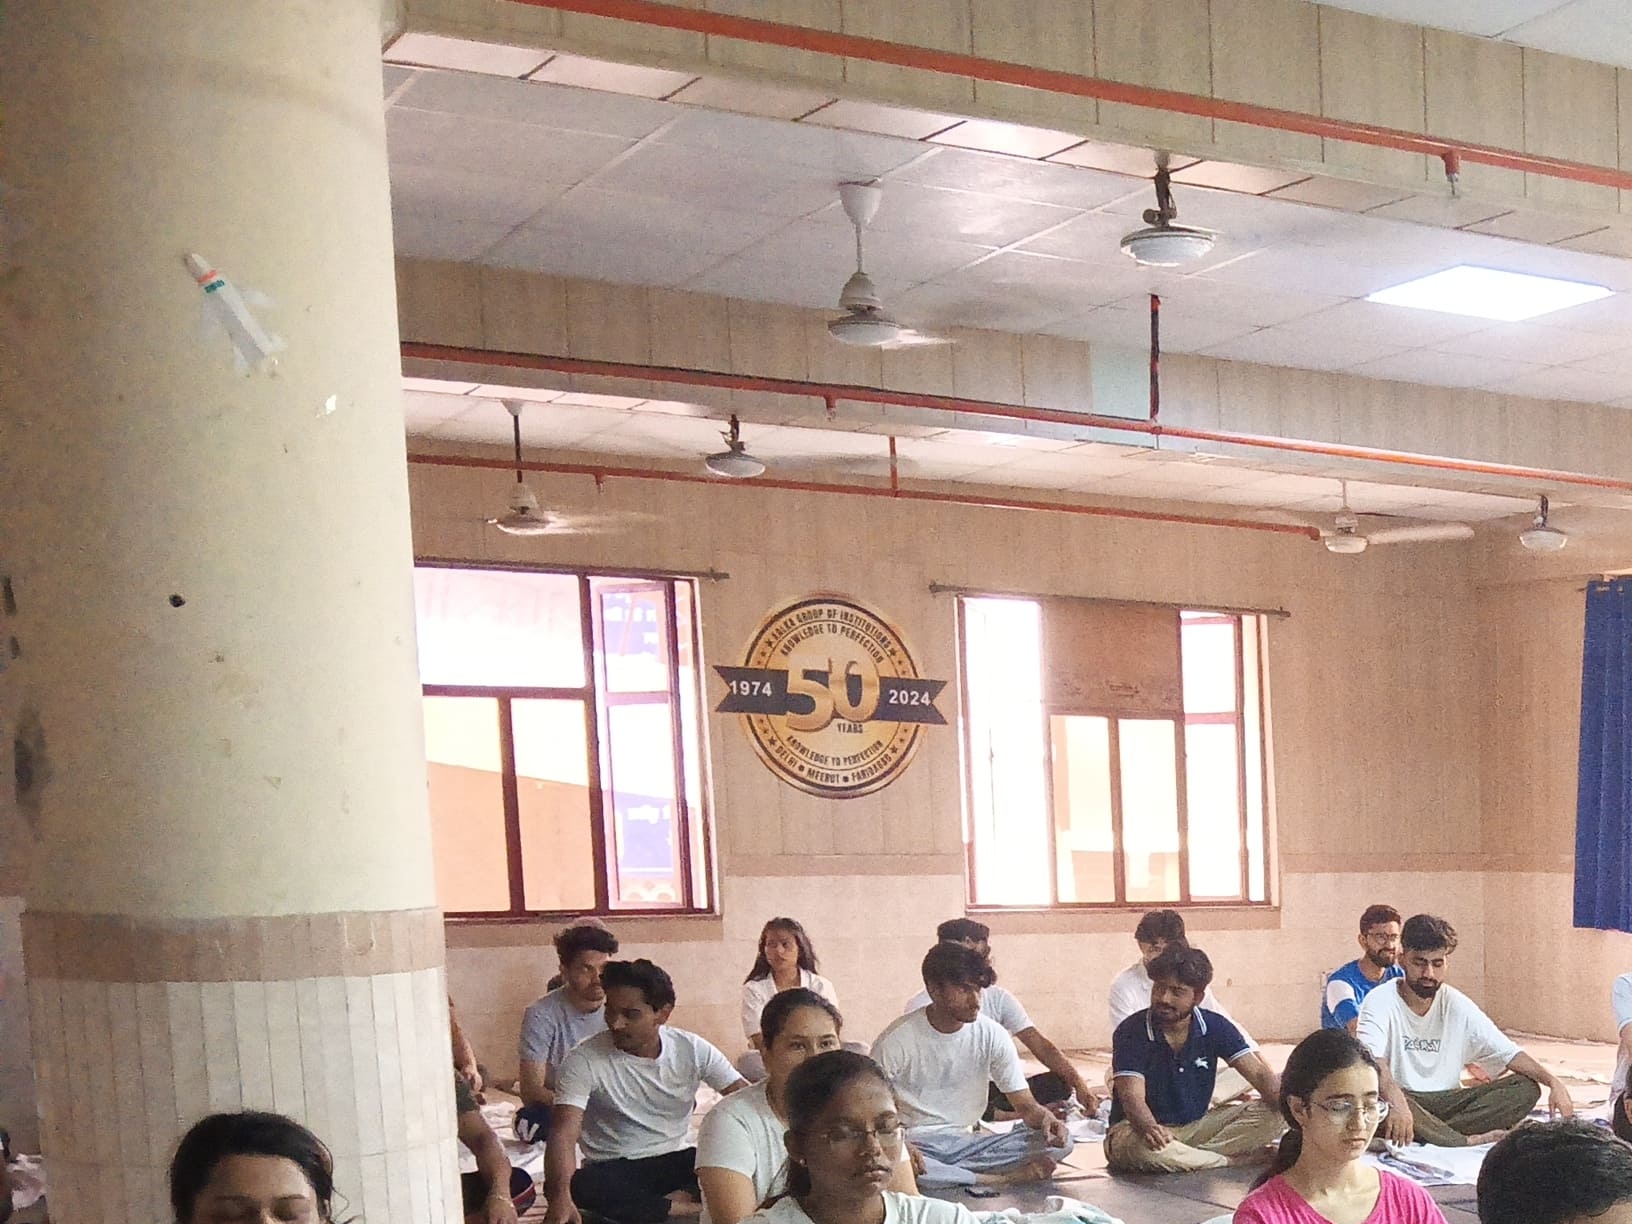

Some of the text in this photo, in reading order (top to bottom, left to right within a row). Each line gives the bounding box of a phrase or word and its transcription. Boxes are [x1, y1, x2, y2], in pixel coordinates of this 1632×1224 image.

[771, 608, 893, 649] KALKA GROUP OF INSTITUTIONS
[780, 624, 884, 663] KNOWLEDGE TO PERFECTION
[729, 680, 772, 697] 1974
[786, 655, 880, 733] 50
[888, 689, 931, 706] 2024
[837, 722, 863, 734] YEARS
[774, 746, 798, 768] DELHI
[807, 768, 840, 784] MEERUT
[787, 735, 883, 766] KNOWLEDGE TO PERFECTION
